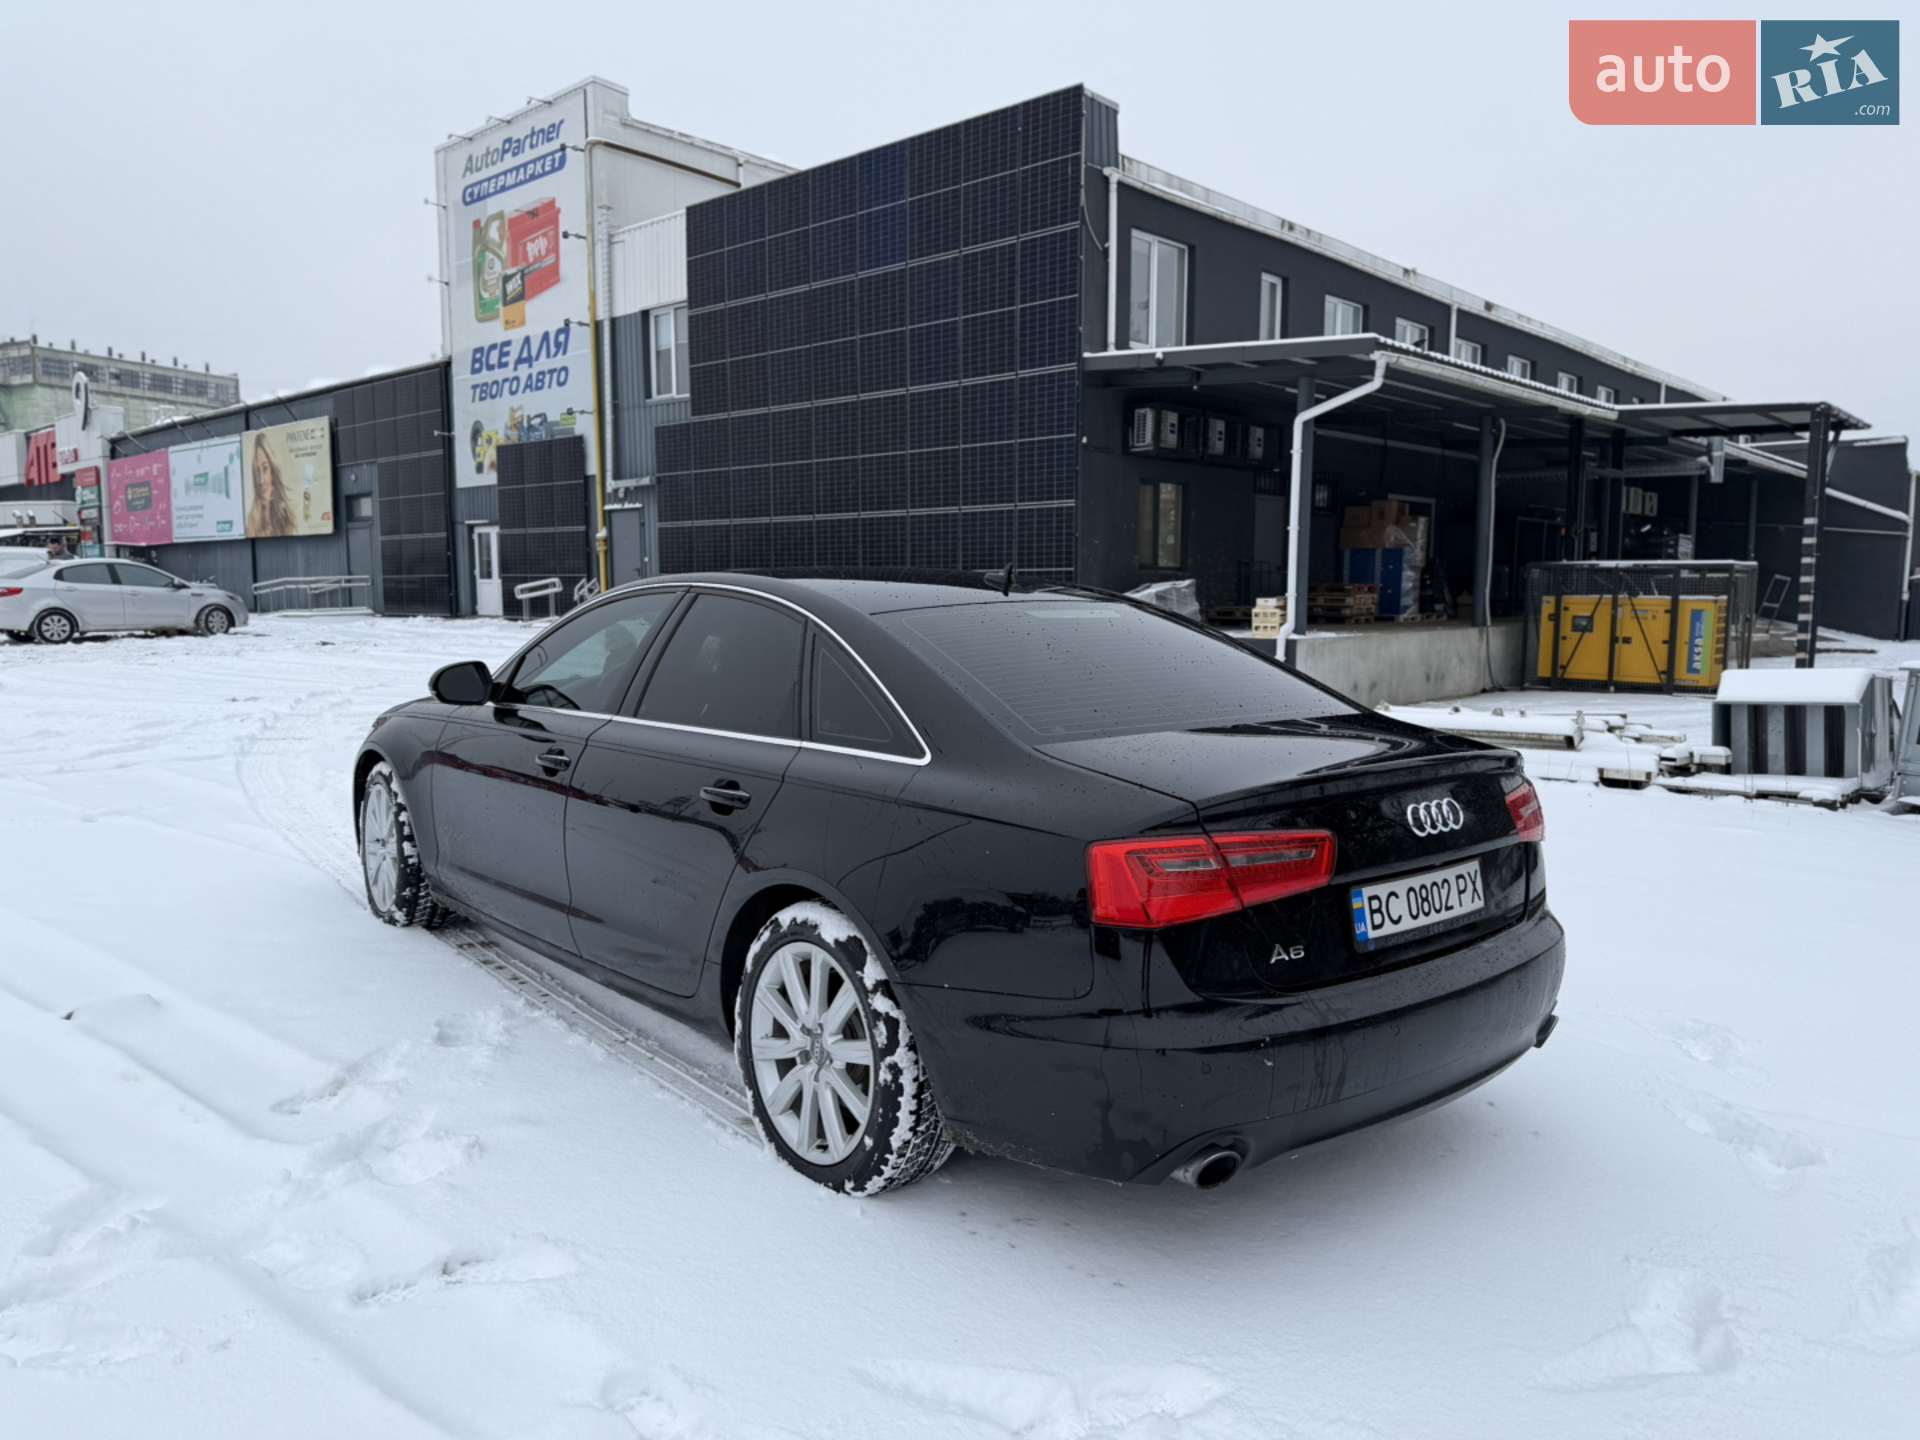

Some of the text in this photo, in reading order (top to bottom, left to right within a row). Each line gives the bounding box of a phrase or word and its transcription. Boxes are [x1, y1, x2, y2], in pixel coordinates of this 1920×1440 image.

[462, 118, 565, 179] AutoPartner
[464, 151, 563, 203] СУПЕРМАРКЕТ
[470, 327, 571, 375] ВСЕ ДЛЯ
[470, 366, 569, 403] ТВОГО АВТО
[1692, 637, 1704, 670] aksa
[1367, 890, 1402, 931] BC
[1406, 878, 1454, 920] 0802
[1455, 869, 1482, 908] PX
[1355, 922, 1367, 934] UA
[1269, 942, 1306, 964] A6
